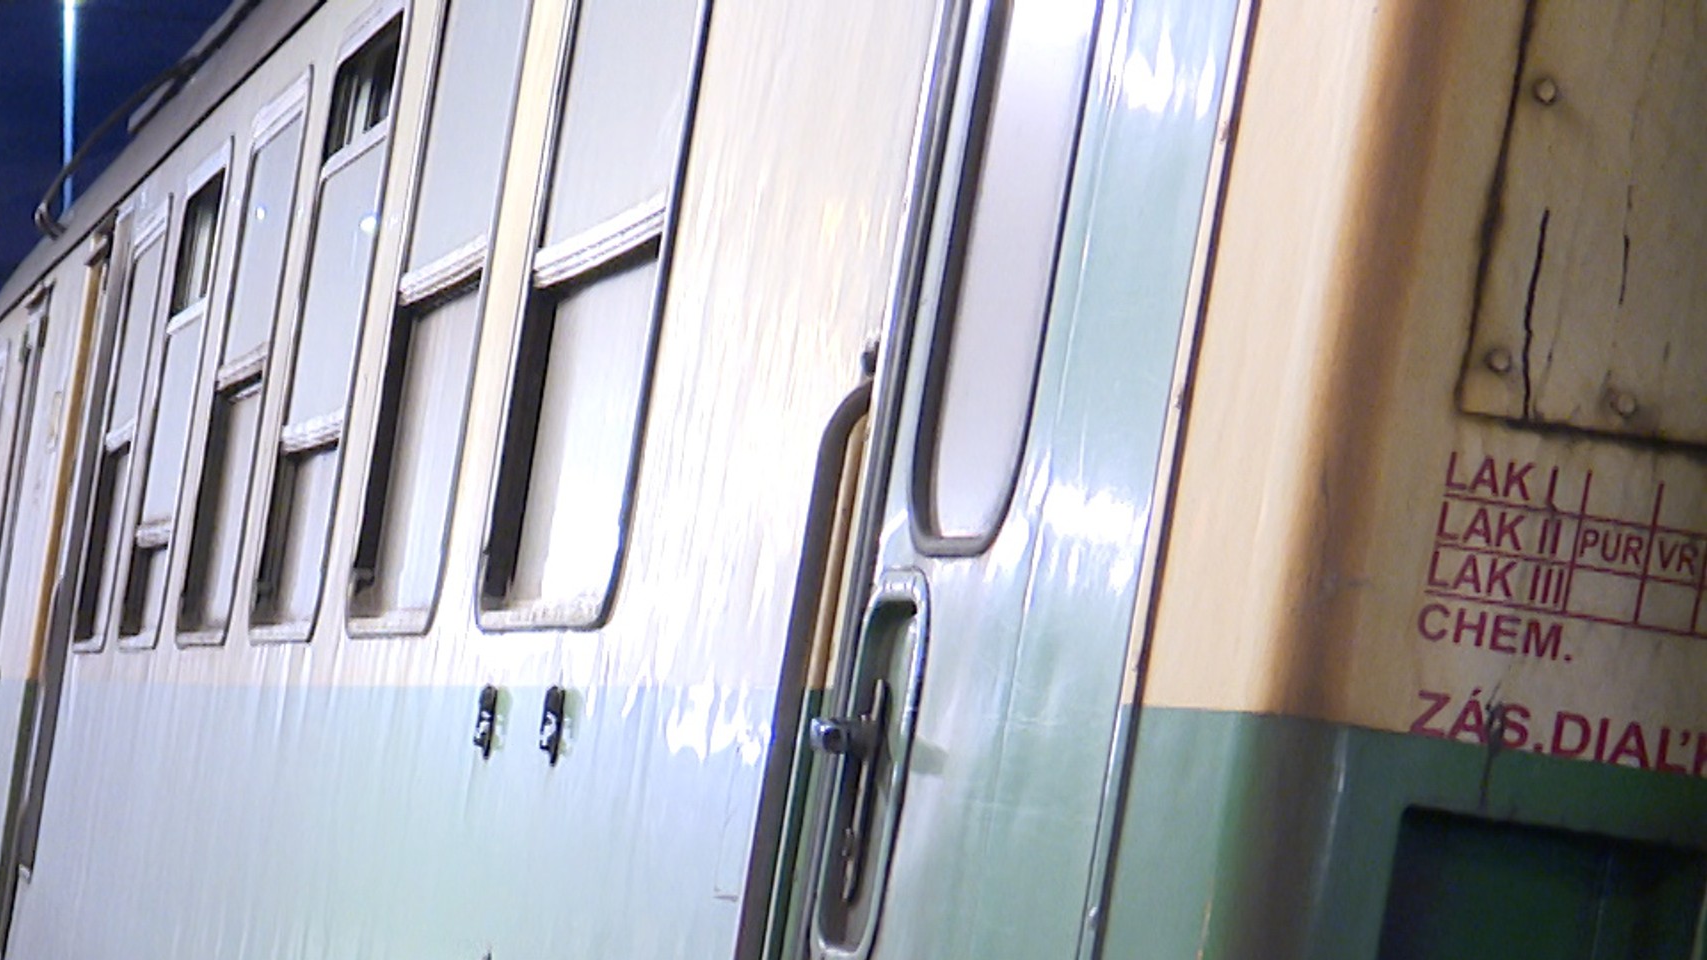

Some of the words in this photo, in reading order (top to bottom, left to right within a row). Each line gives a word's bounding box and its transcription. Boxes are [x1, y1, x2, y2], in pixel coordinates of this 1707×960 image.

[1445, 451, 1535, 501] LAK
[1437, 501, 1525, 552] LAK
[1539, 518, 1562, 555] II
[1579, 528, 1644, 566] PUR
[1658, 540, 1699, 575] VR
[1428, 551, 1517, 599] LAK
[1529, 564, 1564, 605] III
[1417, 603, 1573, 662] CHEM.
